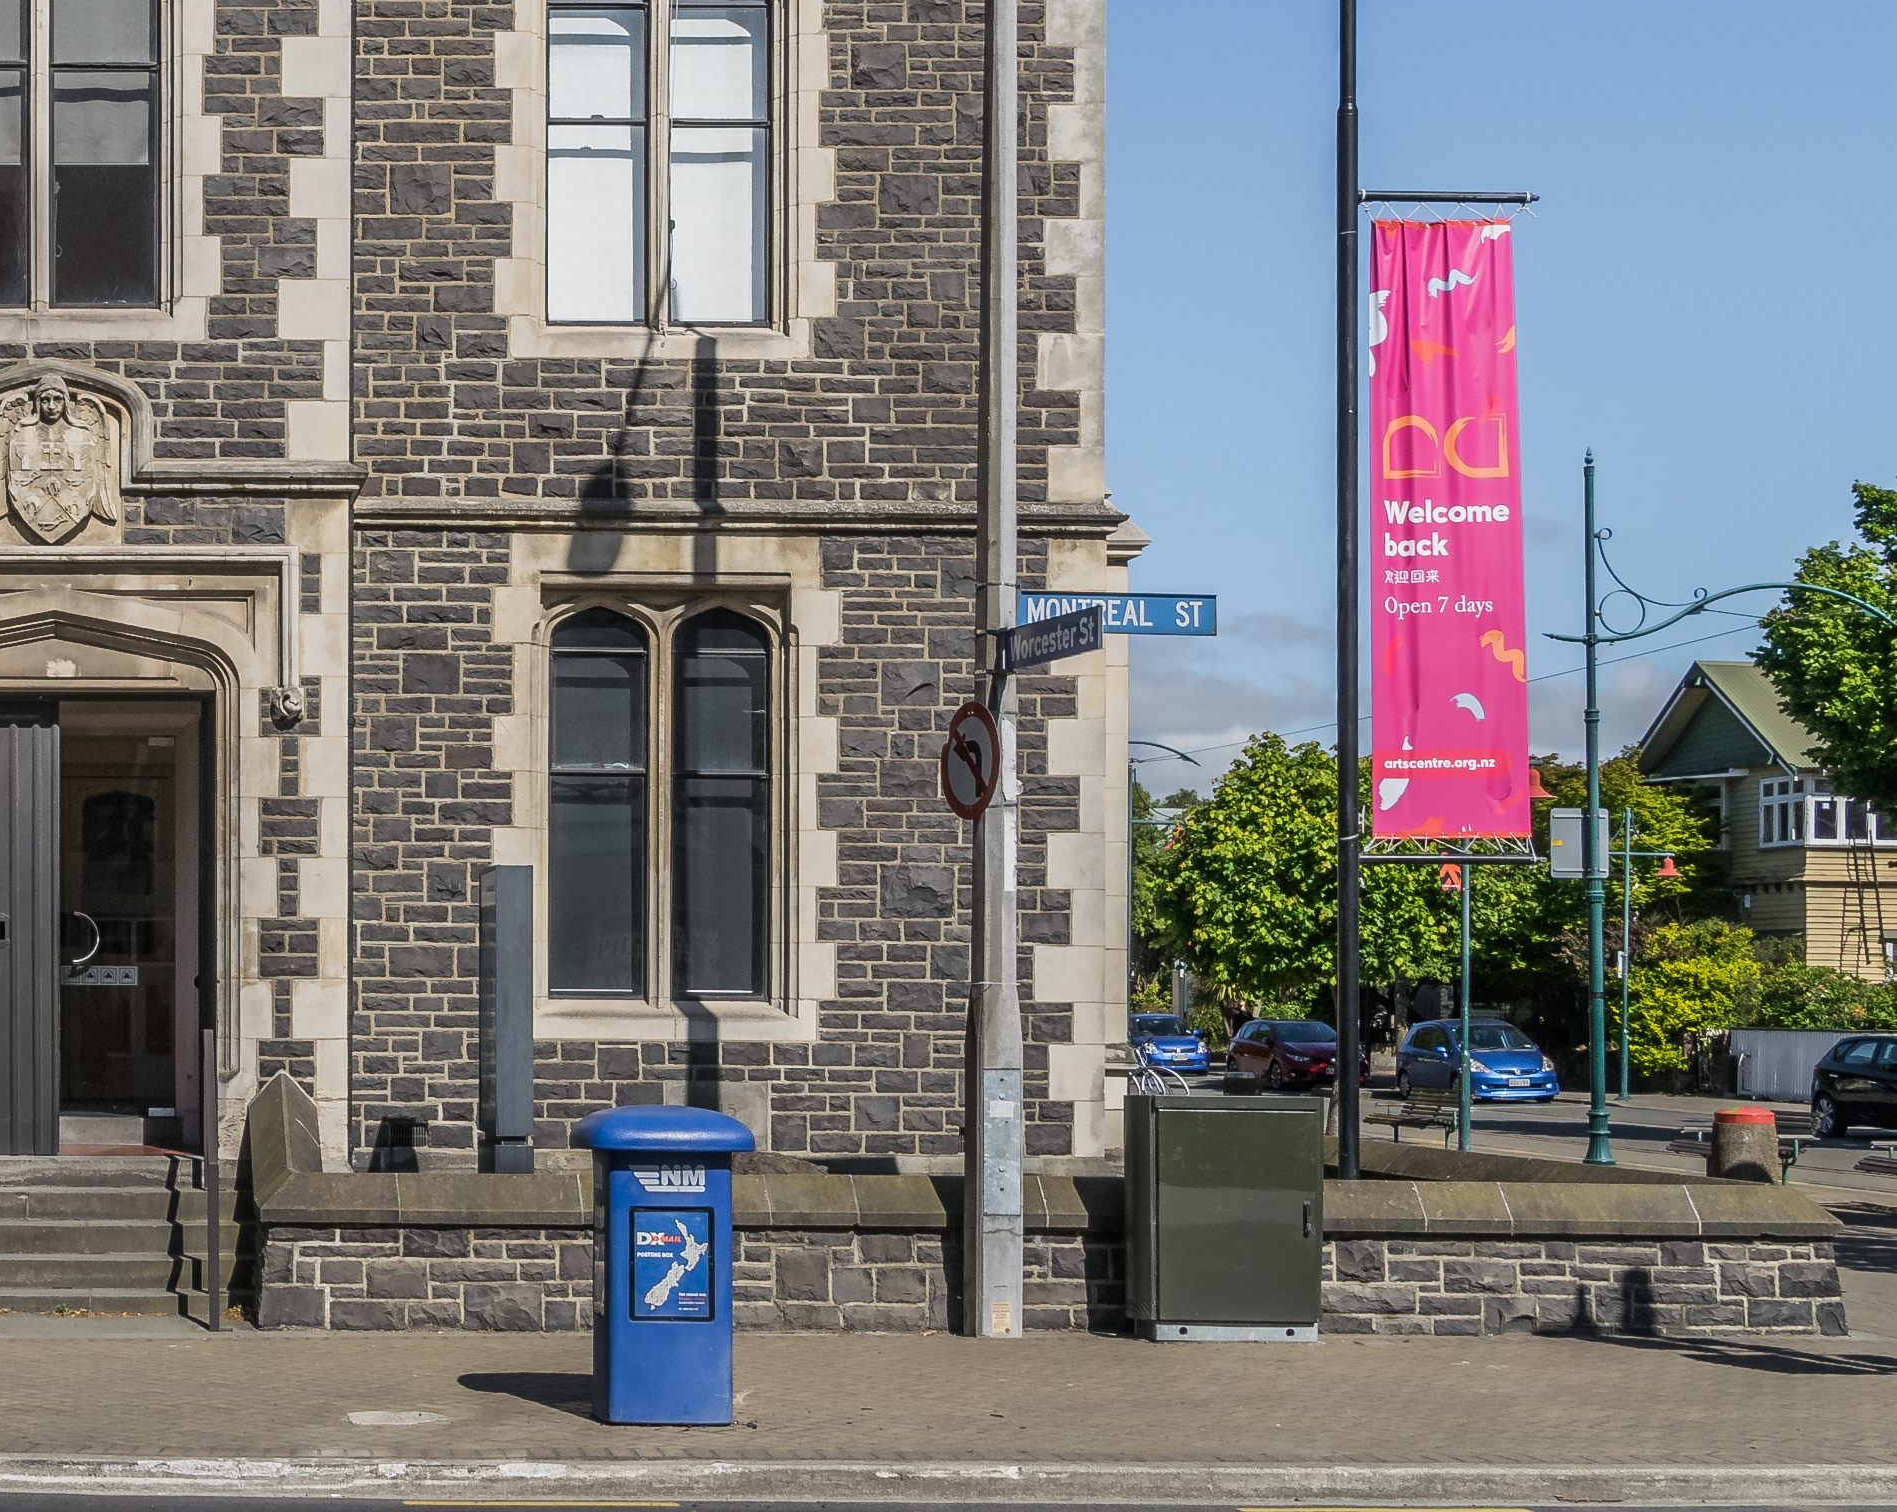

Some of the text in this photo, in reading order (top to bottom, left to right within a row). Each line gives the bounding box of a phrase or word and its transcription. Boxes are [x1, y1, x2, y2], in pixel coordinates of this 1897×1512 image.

[1383, 499, 1510, 524] Welcome
[1384, 532, 1449, 557] back
[1176, 601, 1203, 628] ST
[1384, 595, 1494, 620] Open 7 days
[1010, 615, 1095, 662] Worcester St
[1384, 757, 1496, 771] artscentre.org.nz
